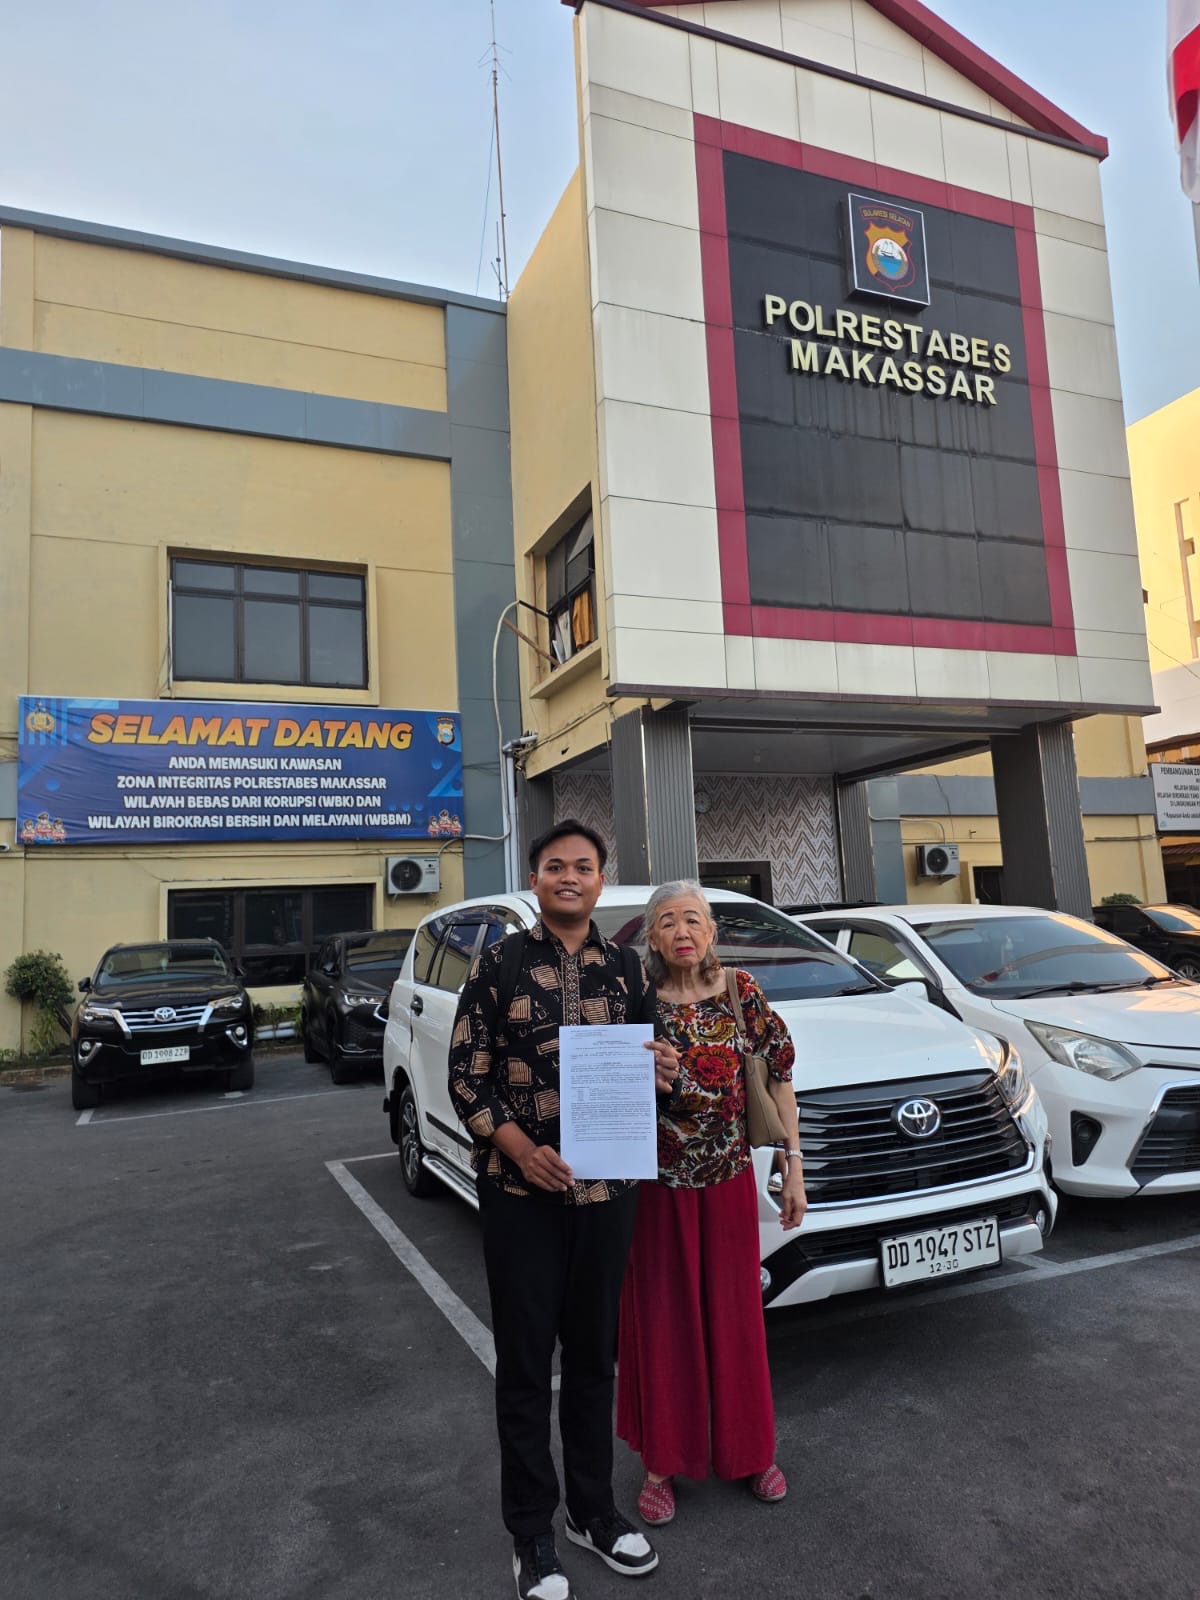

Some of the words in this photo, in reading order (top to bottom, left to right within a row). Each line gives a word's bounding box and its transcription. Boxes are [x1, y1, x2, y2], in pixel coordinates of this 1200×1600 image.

[765, 294, 1012, 373] POLRESTABES
[791, 339, 998, 405] MAKASSAR
[87, 713, 270, 746] SELAMAT
[273, 719, 414, 750] DATANG
[168, 756, 206, 769] ANDA
[208, 757, 278, 770] MEMASUKI
[280, 758, 342, 770] KAWASAN
[117, 775, 155, 788] ZONA
[158, 776, 232, 788] INTEGRITAS
[234, 777, 318, 789] POLRESTABES
[320, 778, 387, 789] MAKASSAR
[123, 795, 185, 809] WILAYAH
[187, 796, 230, 808] BEBAS
[231, 796, 261, 808] DARI
[264, 795, 316, 808] KORUPSI
[318, 795, 355, 807] (WBK)
[356, 795, 381, 807] DAN
[88, 815, 150, 829] WILAYAH
[153, 815, 223, 828] BIROKRASI
[225, 815, 271, 827] BERSIH
[273, 815, 300, 827] DAN
[302, 814, 363, 826] MELAYANI
[364, 814, 412, 826] (WBBM)
[887, 1241, 910, 1269] DD
[914, 1230, 958, 1263] 1947
[963, 1223, 995, 1252] STZ
